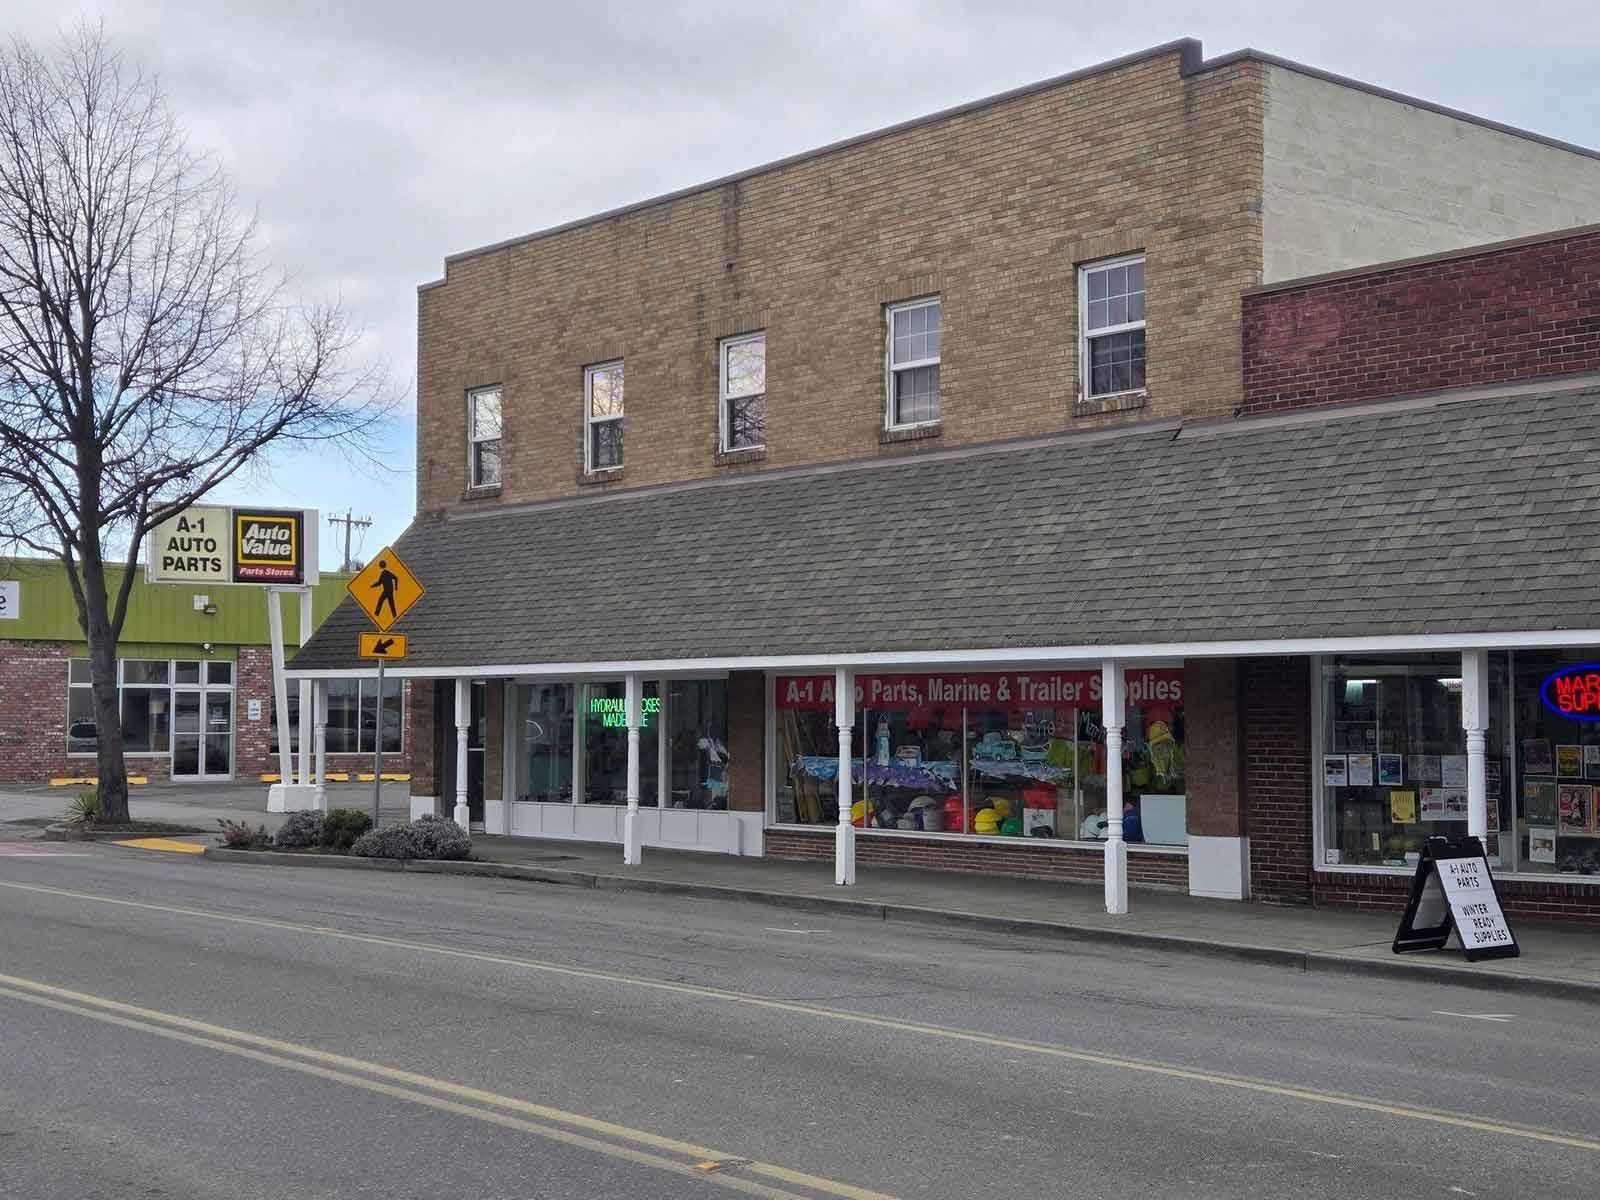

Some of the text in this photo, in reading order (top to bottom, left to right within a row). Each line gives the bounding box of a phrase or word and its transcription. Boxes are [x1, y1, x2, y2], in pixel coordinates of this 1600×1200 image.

[176, 516, 206, 534] A-1
[245, 523, 290, 541] Auto
[168, 537, 217, 553] AUTO
[242, 539, 292, 556] Value
[163, 556, 222, 572] PARTS
[240, 567, 295, 577] Parts Stores
[787, 674, 1182, 706] A-1 Ao Parts, Marine & Trailer Splies
[640, 697, 661, 713] OSES
[1559, 693, 1600, 712] SUP
[1461, 862, 1478, 874] AUTO
[1457, 877, 1480, 888] PARTS
[1462, 903, 1489, 916] WINTER
[1473, 917, 1496, 928] READY
[1474, 930, 1507, 943] SUPPLIES
